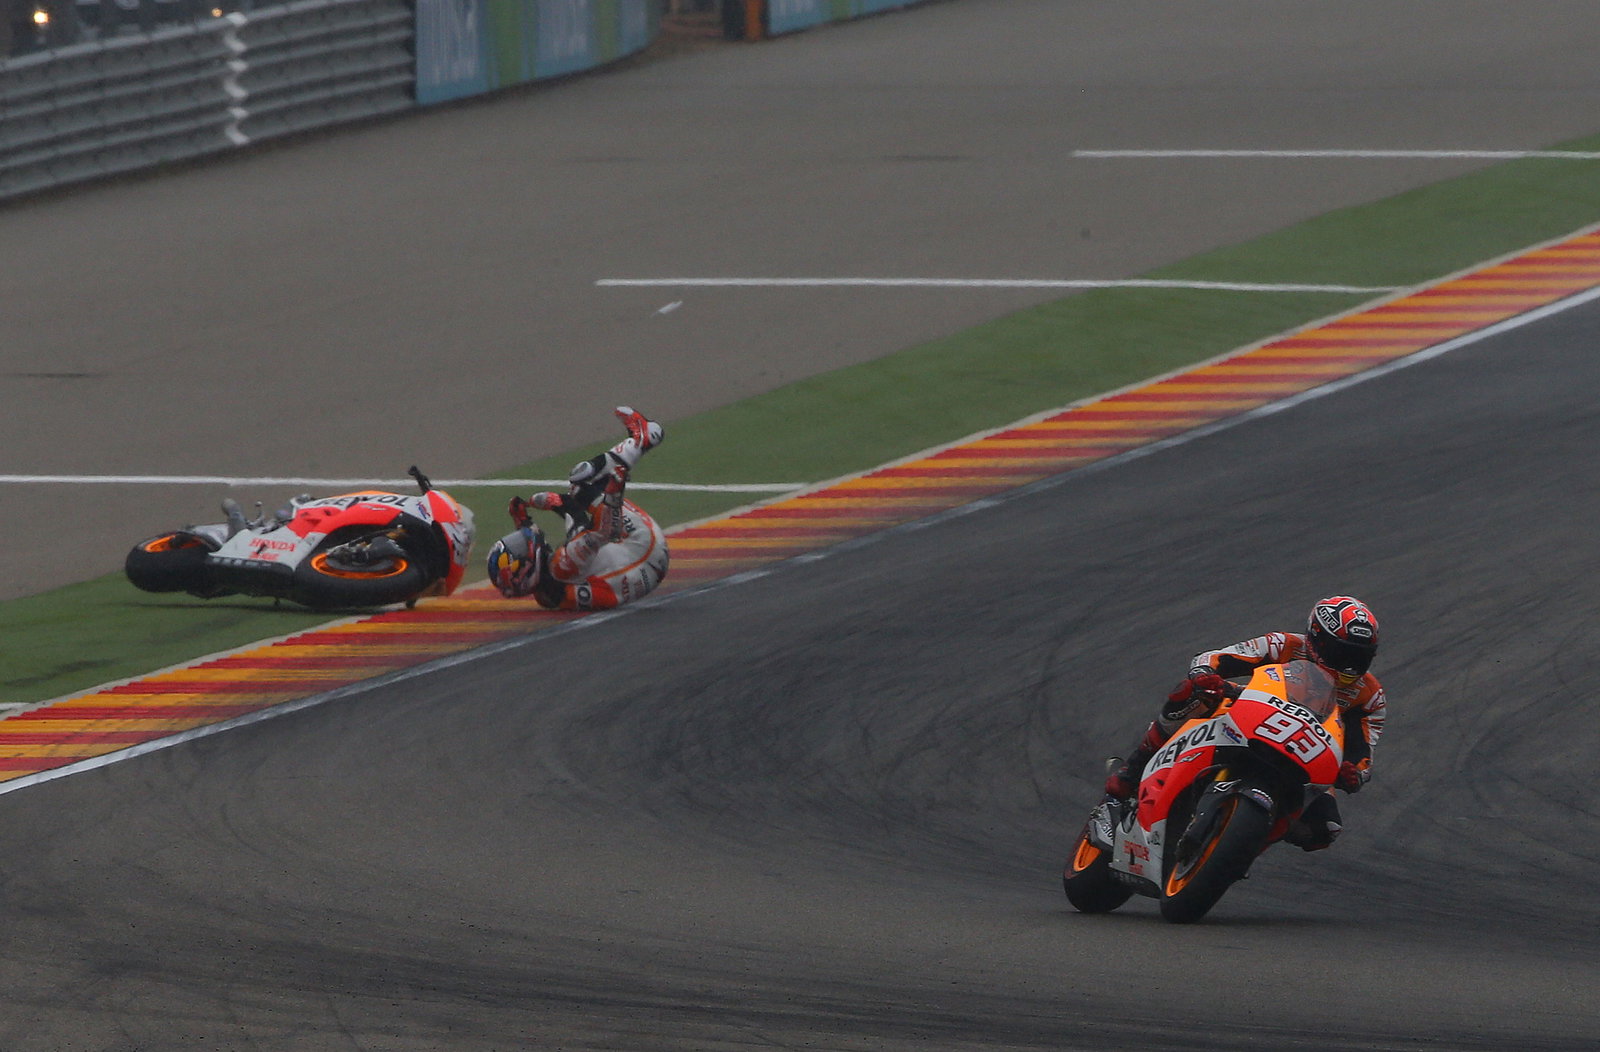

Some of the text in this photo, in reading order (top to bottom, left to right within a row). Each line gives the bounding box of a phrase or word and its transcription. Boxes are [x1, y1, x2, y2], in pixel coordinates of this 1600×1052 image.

[248, 537, 296, 552] HONDA
[1319, 606, 1338, 629] LOTUS
[1254, 711, 1327, 764] 93
[1268, 696, 1333, 746] REPSOL
